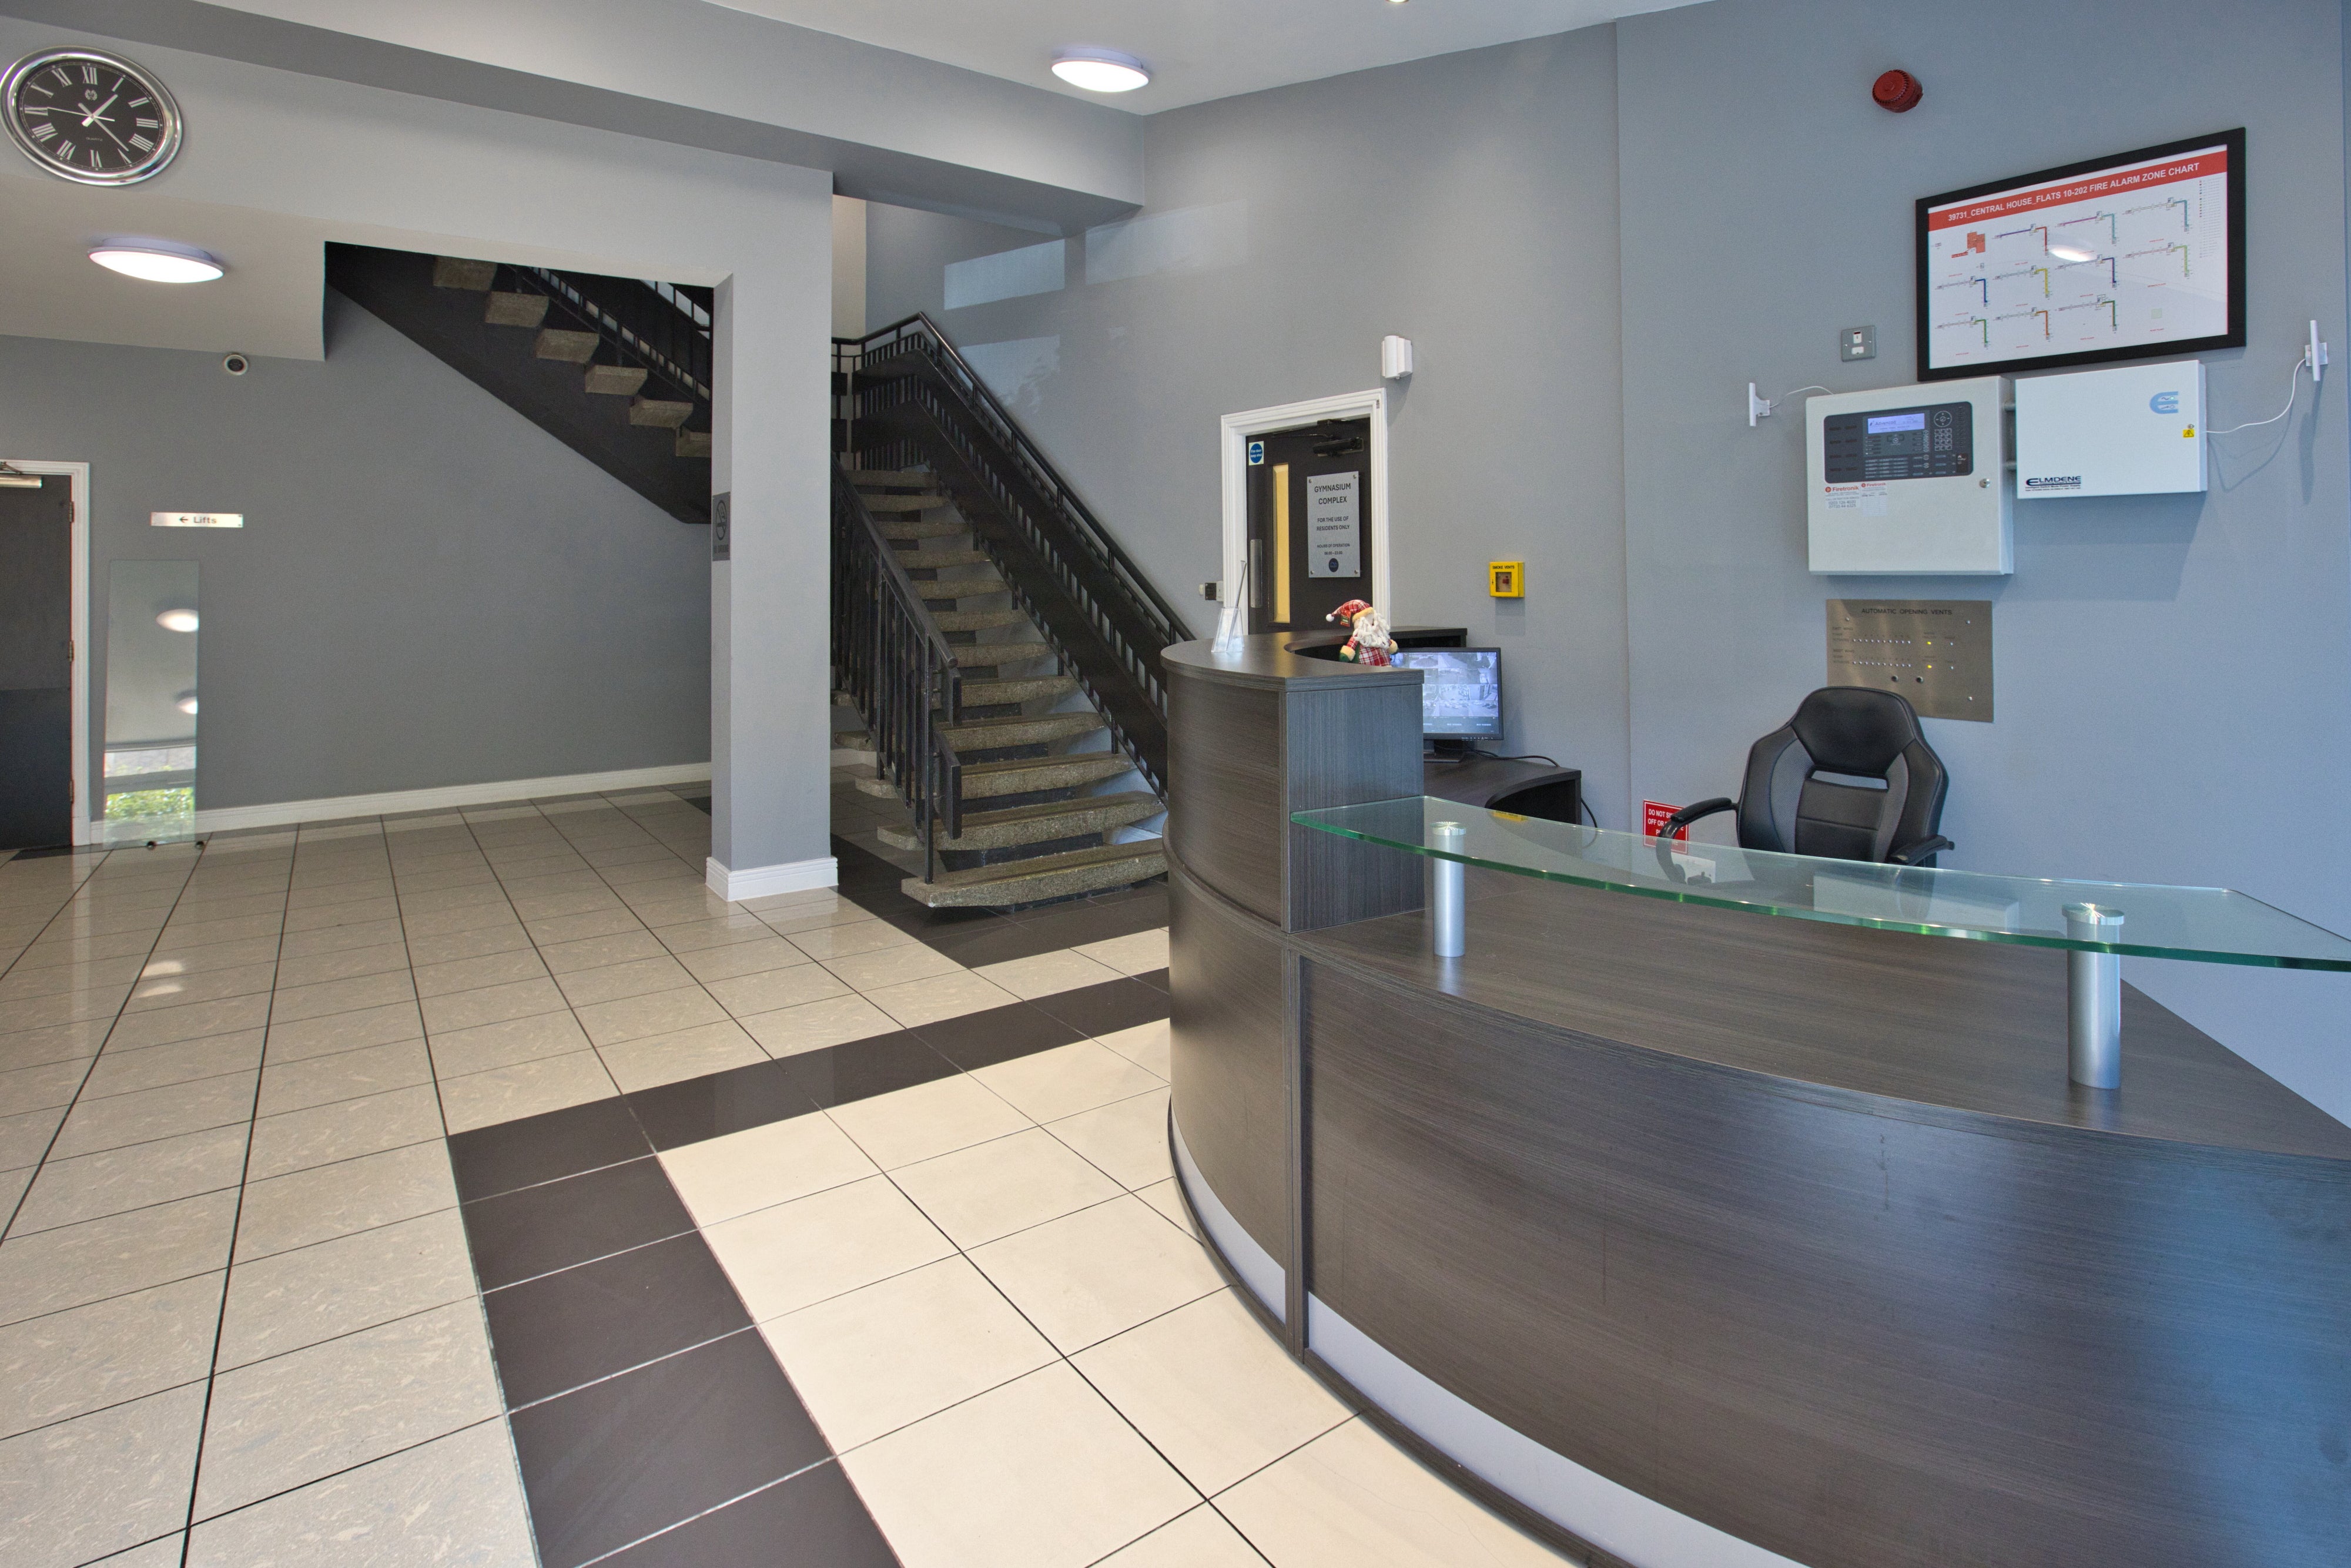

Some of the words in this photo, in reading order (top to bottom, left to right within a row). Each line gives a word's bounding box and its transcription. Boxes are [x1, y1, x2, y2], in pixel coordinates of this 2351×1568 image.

[52, 68, 72, 87] XI
[82, 66, 98, 85] XII
[128, 97, 150, 108] II
[136, 118, 158, 128] III
[32, 123, 58, 142] VIII
[57, 140, 76, 160] VII
[91, 150, 102, 167] VI
[1948, 203, 2005, 221] 39731_CENTRAL
[2007, 192, 2061, 209] HOUSE_FLATS
[2064, 186, 2088, 197] 10-202
[2089, 182, 2108, 192] FIRE
[2110, 176, 2140, 187] ALARM
[2142, 170, 2166, 182] ZONE
[2168, 163, 2199, 176] CHART
[1314, 483, 1351, 492] GYMNASIUM
[2025, 475, 2081, 486] ELMDENE
[1318, 496, 1347, 504] COMPLEX
